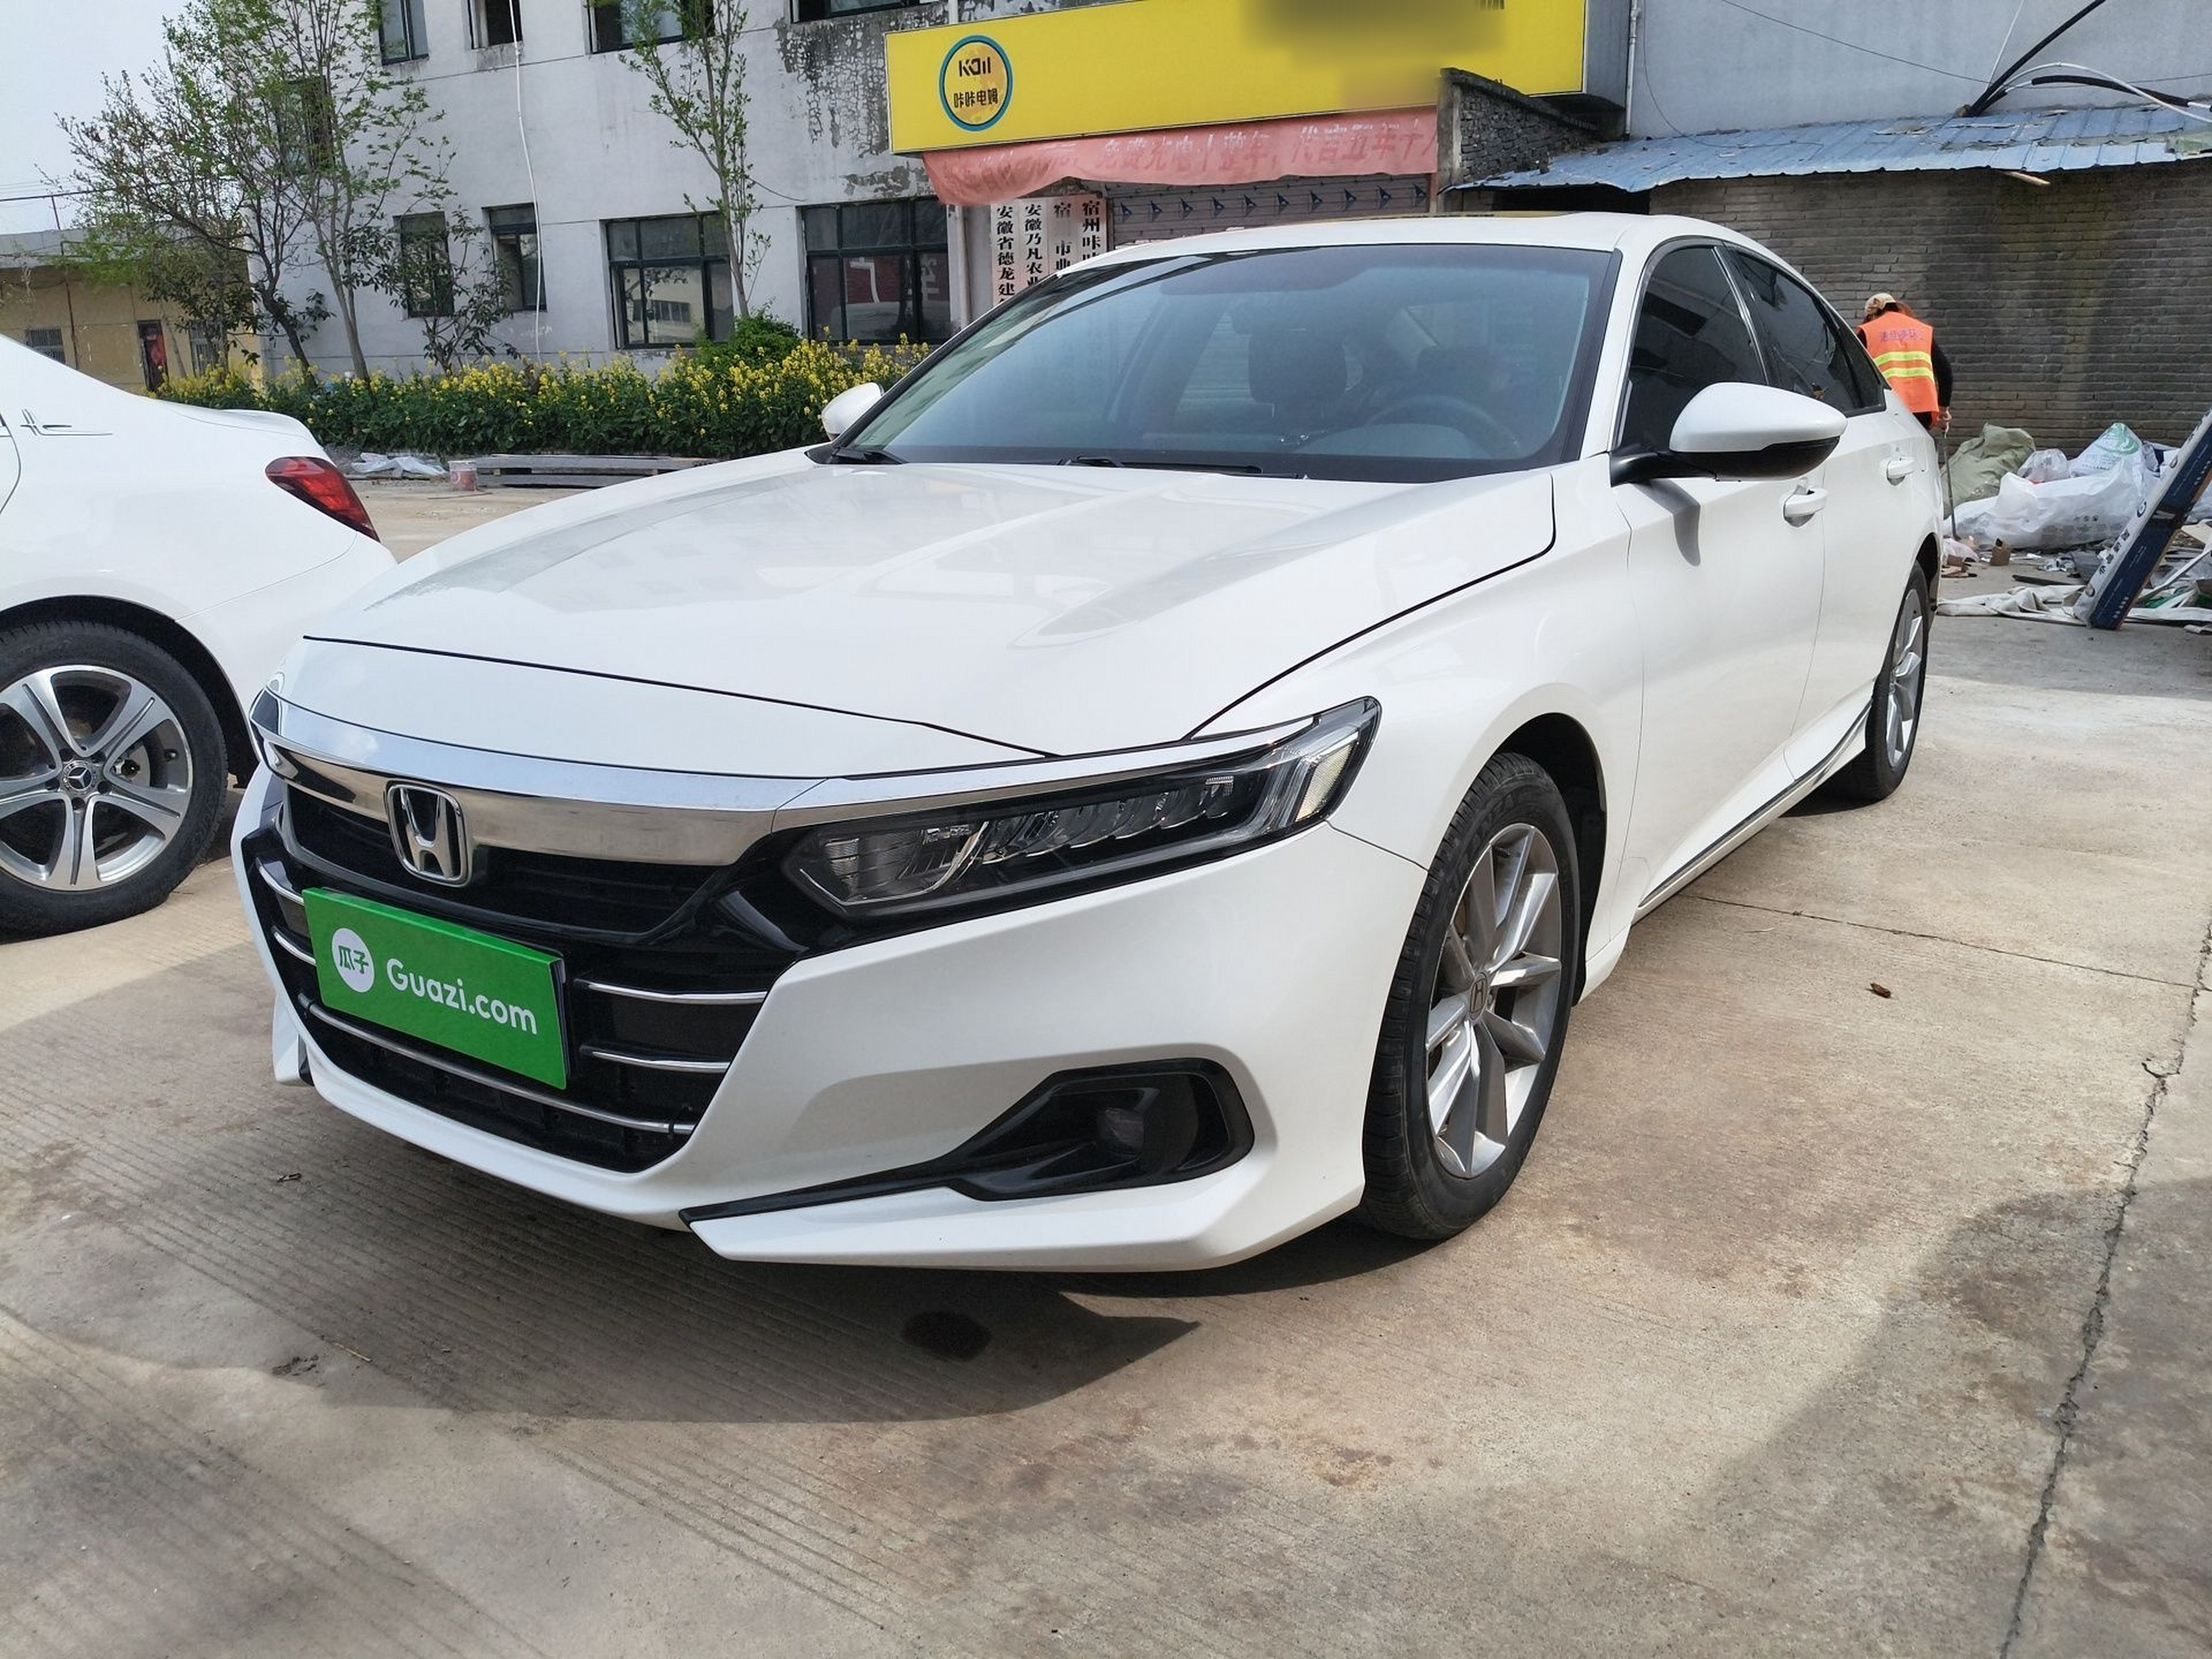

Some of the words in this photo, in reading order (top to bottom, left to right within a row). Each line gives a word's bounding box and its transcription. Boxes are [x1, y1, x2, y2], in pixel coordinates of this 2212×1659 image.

[997, 206, 1016, 304] 安徽省德龙建
[338, 945, 369, 975] 瓜子
[386, 957, 537, 1035] Guazi.com
